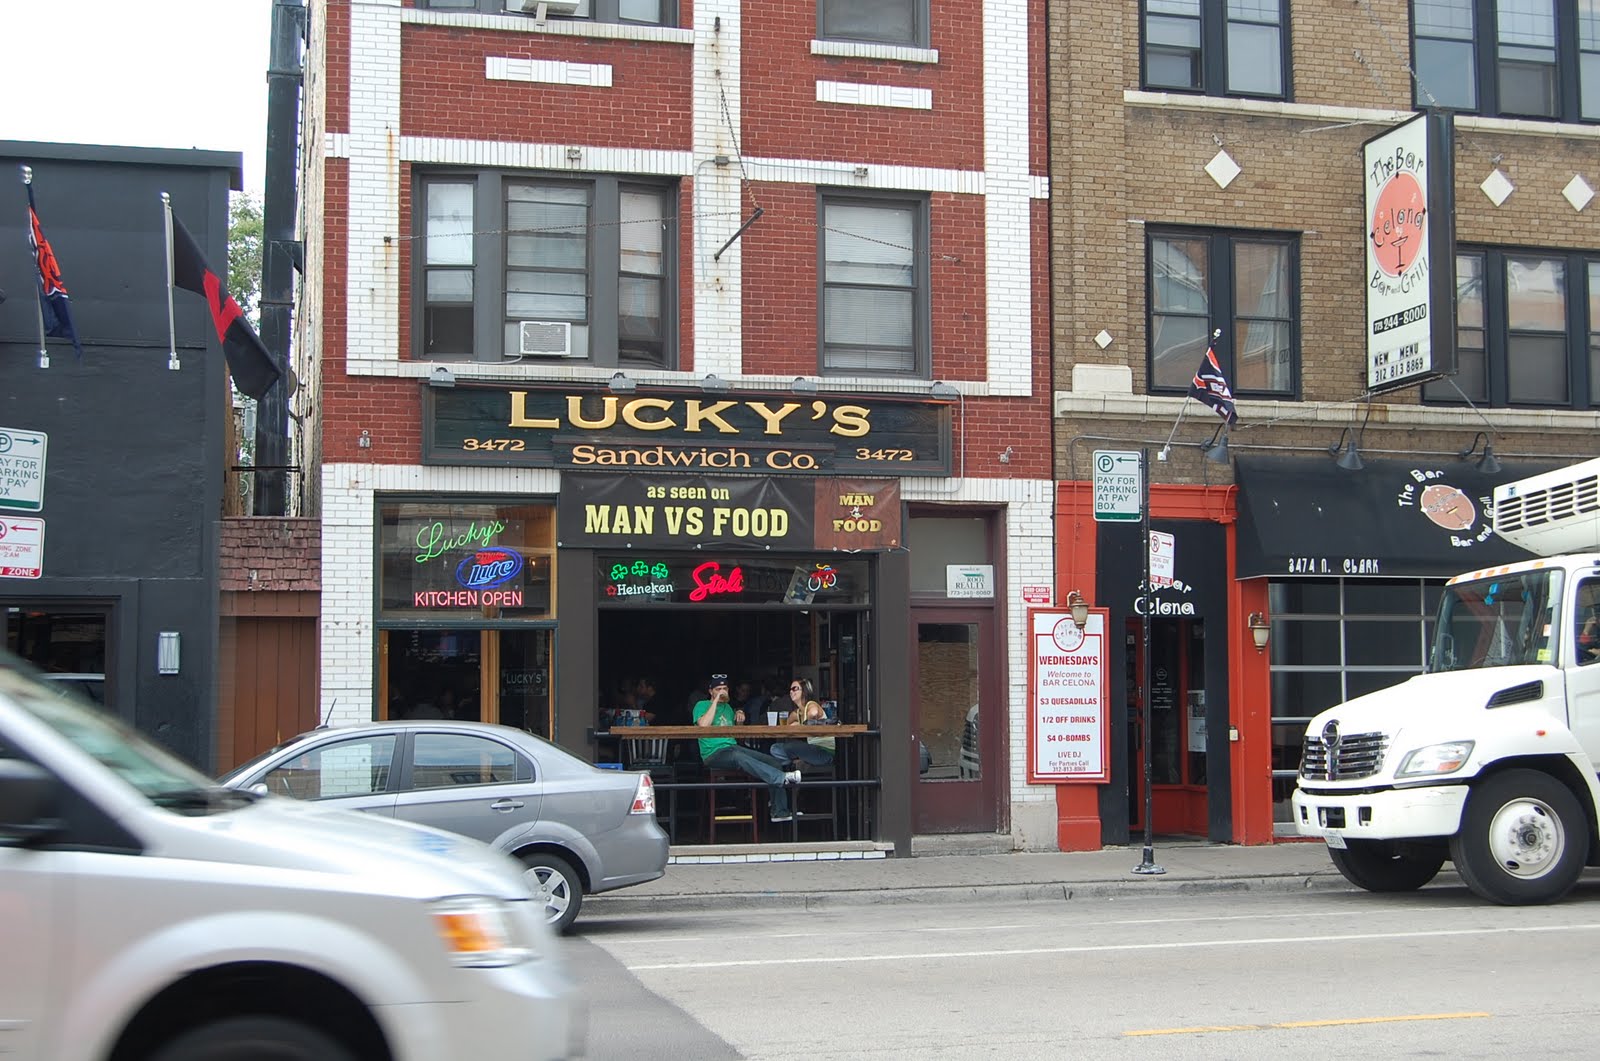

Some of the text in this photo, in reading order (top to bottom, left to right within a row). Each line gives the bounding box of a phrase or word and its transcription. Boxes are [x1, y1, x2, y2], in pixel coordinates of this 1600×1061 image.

[1370, 146, 1424, 188] The Bar
[1370, 270, 1391, 296] Bar
[1401, 257, 1429, 294] Grill
[1383, 304, 1427, 331] 244-8000
[1400, 343, 1419, 358] MENU
[1375, 357, 1424, 382] 312 813 8869
[508, 391, 871, 437] LUCKY'S
[463, 438, 525, 452] 3472
[572, 445, 820, 470] Sandwich Co.
[855, 448, 913, 461] 3472
[0, 458, 37, 469] AY FOR
[0, 468, 39, 480] ARKING
[1097, 476, 1135, 485] PAY FOR
[7, 478, 29, 488] PAY
[1097, 485, 1137, 494] PARKING
[1398, 484, 1414, 507] The
[1410, 469, 1445, 482] Bar
[0, 487, 10, 496] OX
[647, 486, 730, 500] as seen on
[839, 495, 875, 506] MAN
[1097, 502, 1116, 510] BOX
[584, 504, 789, 538] MAN VS FOOD
[833, 520, 882, 532] FOOD
[415, 520, 505, 563] Lucky's
[1450, 535, 1474, 547] Bar
[1476, 524, 1493, 542] and
[9, 567, 35, 576] ZONE
[467, 560, 514, 585] Lite
[1288, 557, 1315, 573] 3474
[1343, 558, 1379, 574] CLARK
[689, 561, 745, 601] Stoli
[617, 582, 674, 596] Heineken
[415, 591, 522, 606] KITCHEN OPEN
[1039, 655, 1098, 665] WEDNESDAYS
[1042, 679, 1096, 687] BAR CELONA
[1051, 697, 1097, 705] QUESADILLAS
[1042, 716, 1053, 724] 1/2
